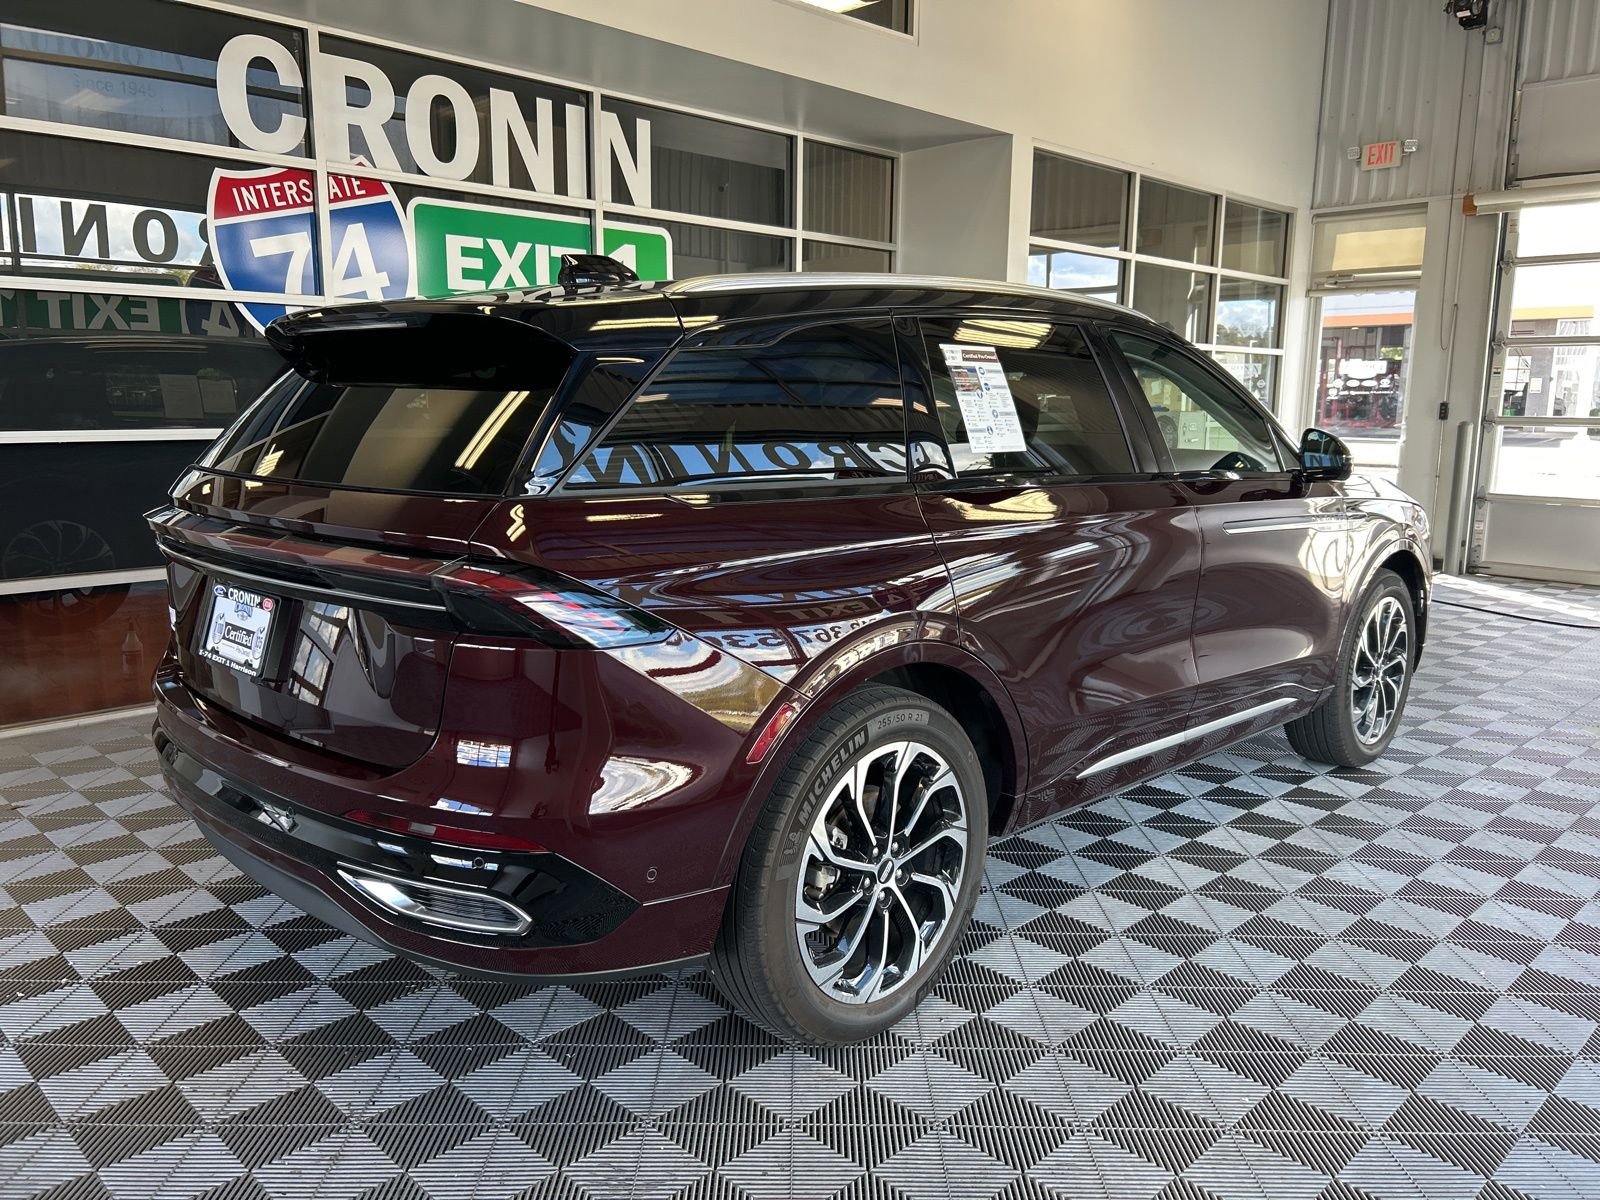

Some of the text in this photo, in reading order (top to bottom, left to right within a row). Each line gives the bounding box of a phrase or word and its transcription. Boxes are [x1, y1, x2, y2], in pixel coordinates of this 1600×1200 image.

[120, 80, 157, 99] 1945
[216, 33, 651, 208] CRONIN
[1367, 143, 1396, 166] EXIT
[232, 174, 366, 212] INTERSATE
[250, 222, 391, 312] 74
[446, 234, 588, 290] EXIT
[228, 588, 261, 607] CRONIN
[225, 625, 253, 647] Certified
[199, 649, 211, 659] I-74
[212, 654, 226, 664] EXIT
[231, 661, 257, 676] Harrison
[877, 712, 923, 730] 255/50 R 21
[799, 731, 866, 826] MICHELIN
